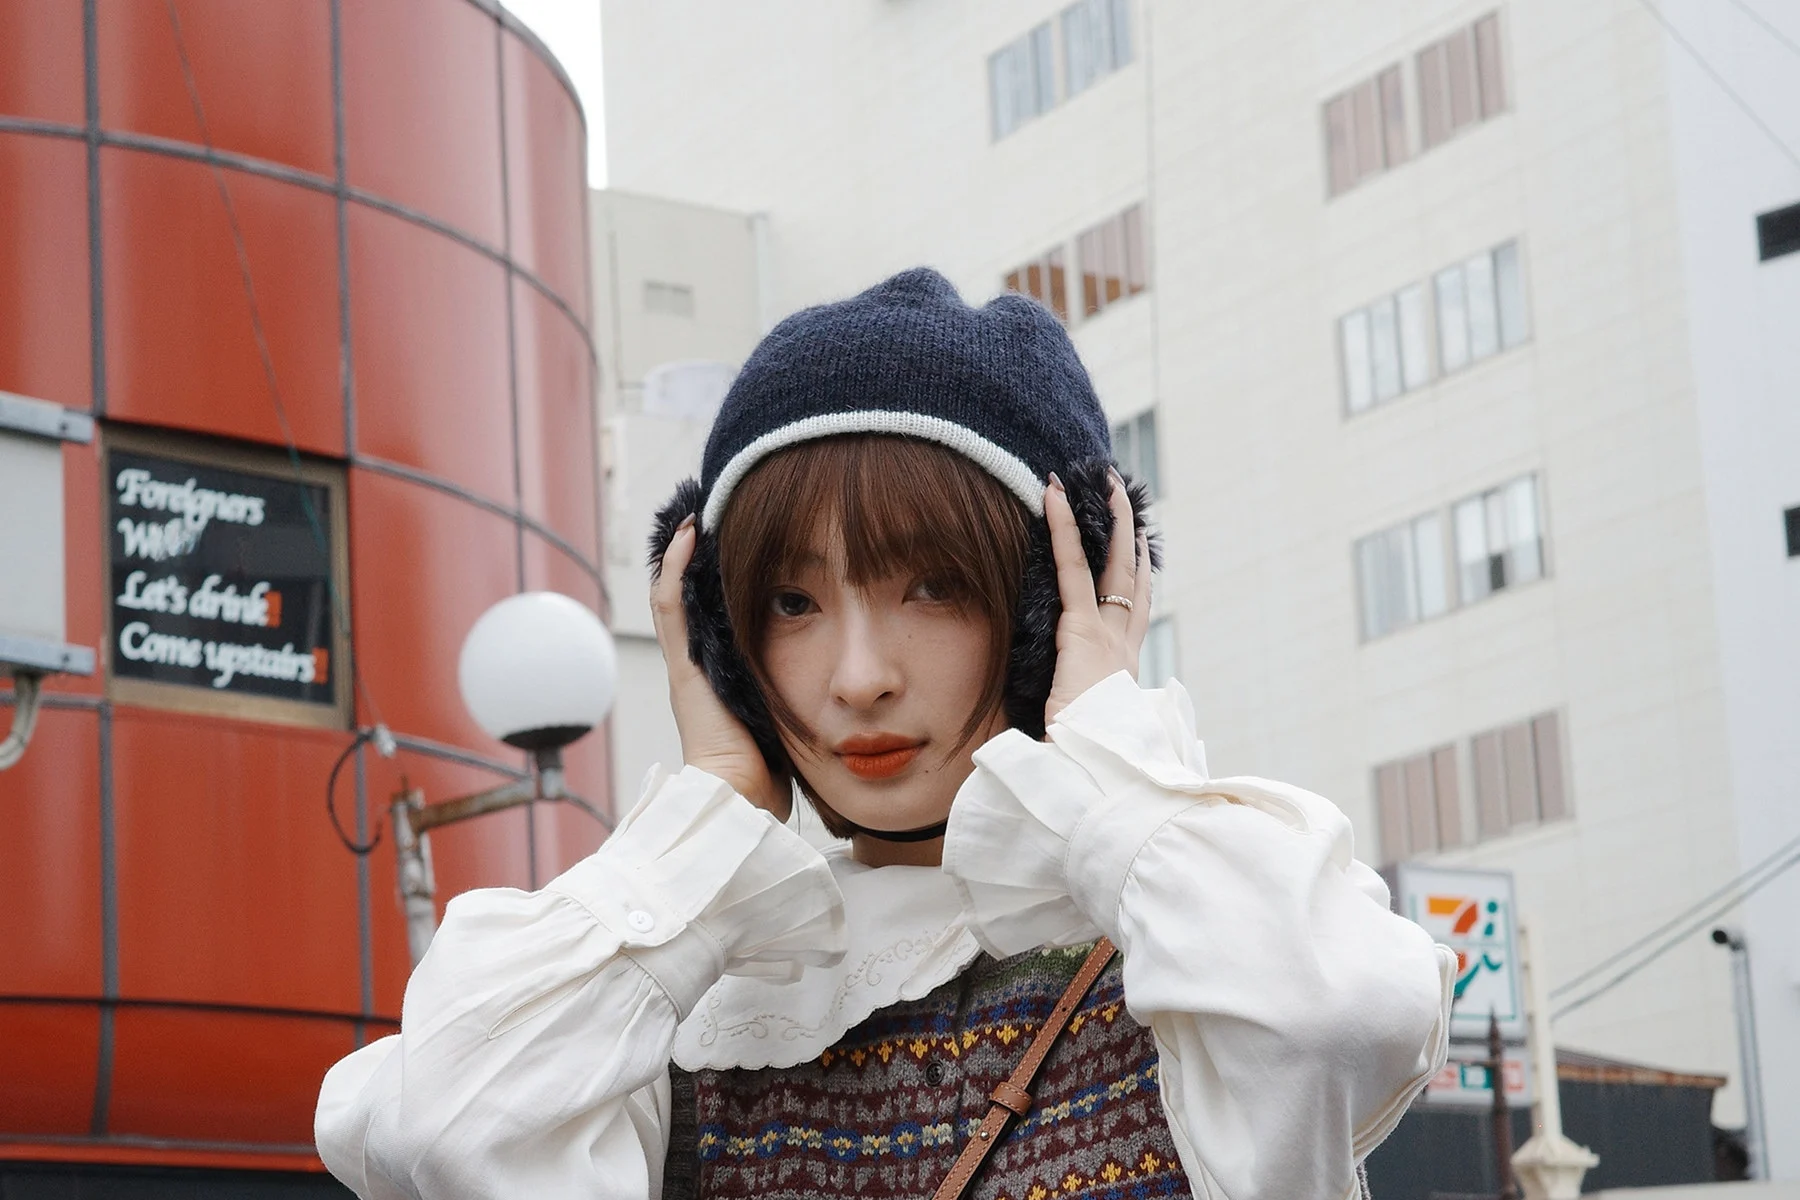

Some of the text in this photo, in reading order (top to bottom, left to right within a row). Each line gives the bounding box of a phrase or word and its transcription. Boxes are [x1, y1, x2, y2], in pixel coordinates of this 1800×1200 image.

[116, 468, 265, 526] Foreigners
[116, 570, 187, 615] Let's
[119, 621, 201, 668] Come
